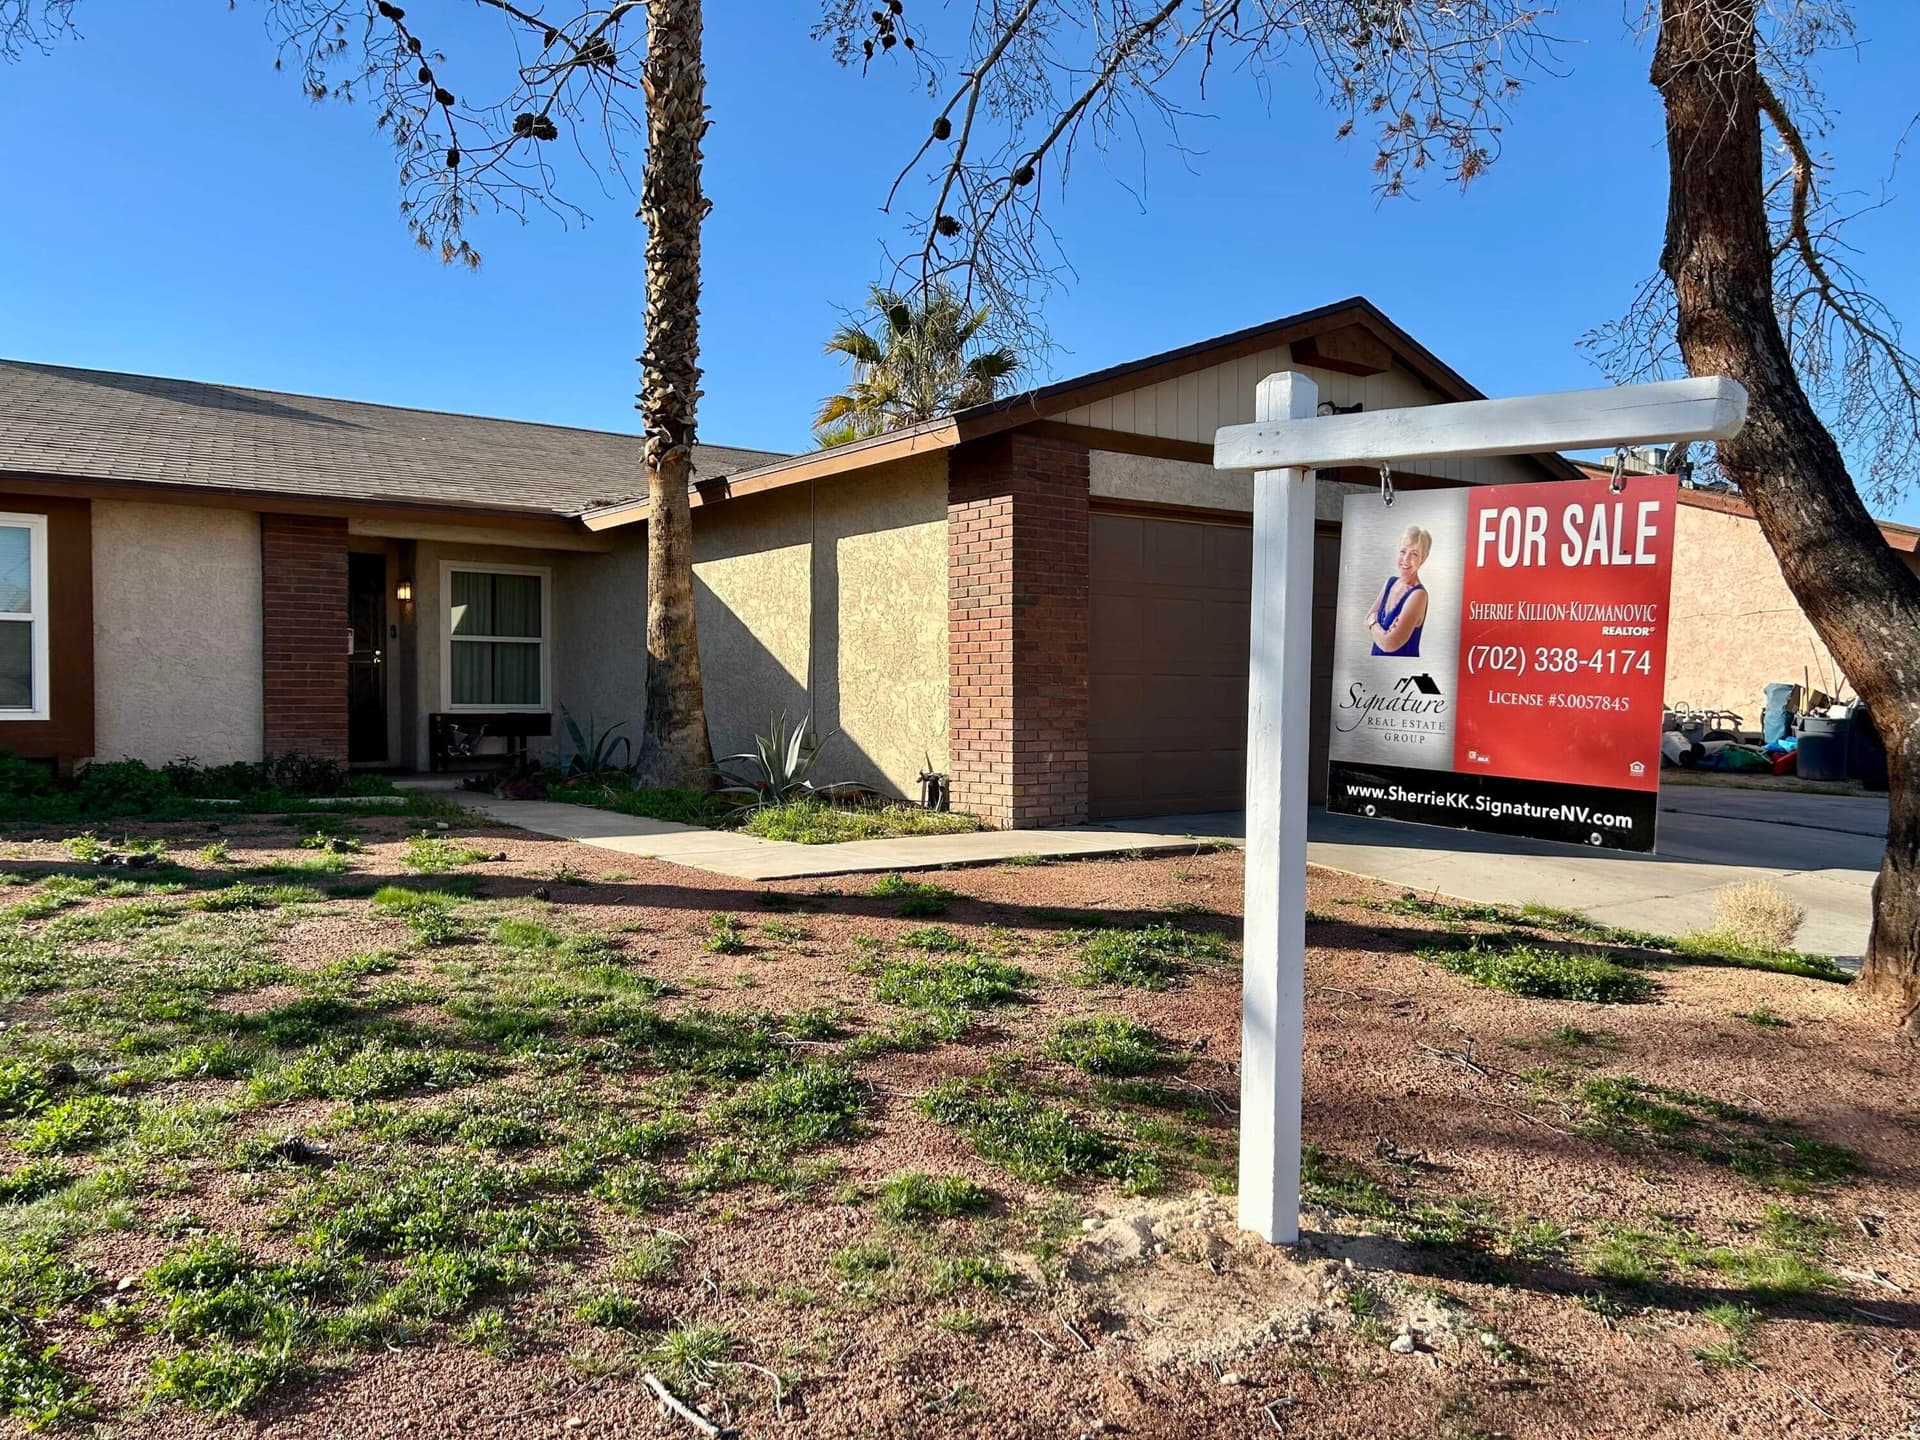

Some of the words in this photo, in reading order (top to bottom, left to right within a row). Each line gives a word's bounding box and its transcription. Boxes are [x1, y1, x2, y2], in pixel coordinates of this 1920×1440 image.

[1476, 506, 1549, 568] FOR
[1560, 501, 1660, 568] SALE
[1469, 600, 1514, 621] SHERRIE
[1517, 600, 1657, 623] KILLION-KUZMANOVIC
[1467, 645, 1527, 677] (702)
[1534, 647, 1652, 676] 338-4174
[1335, 681, 1449, 733] Signature
[1488, 690, 1544, 707] LICENSE
[1548, 693, 1630, 712] #S.0057845
[1367, 716, 1397, 728] REAL
[1402, 719, 1446, 731] ESTATE
[1384, 732, 1426, 744] GROUP
[1346, 784, 1633, 829] www.SherrieKK.SignatureNV.com
